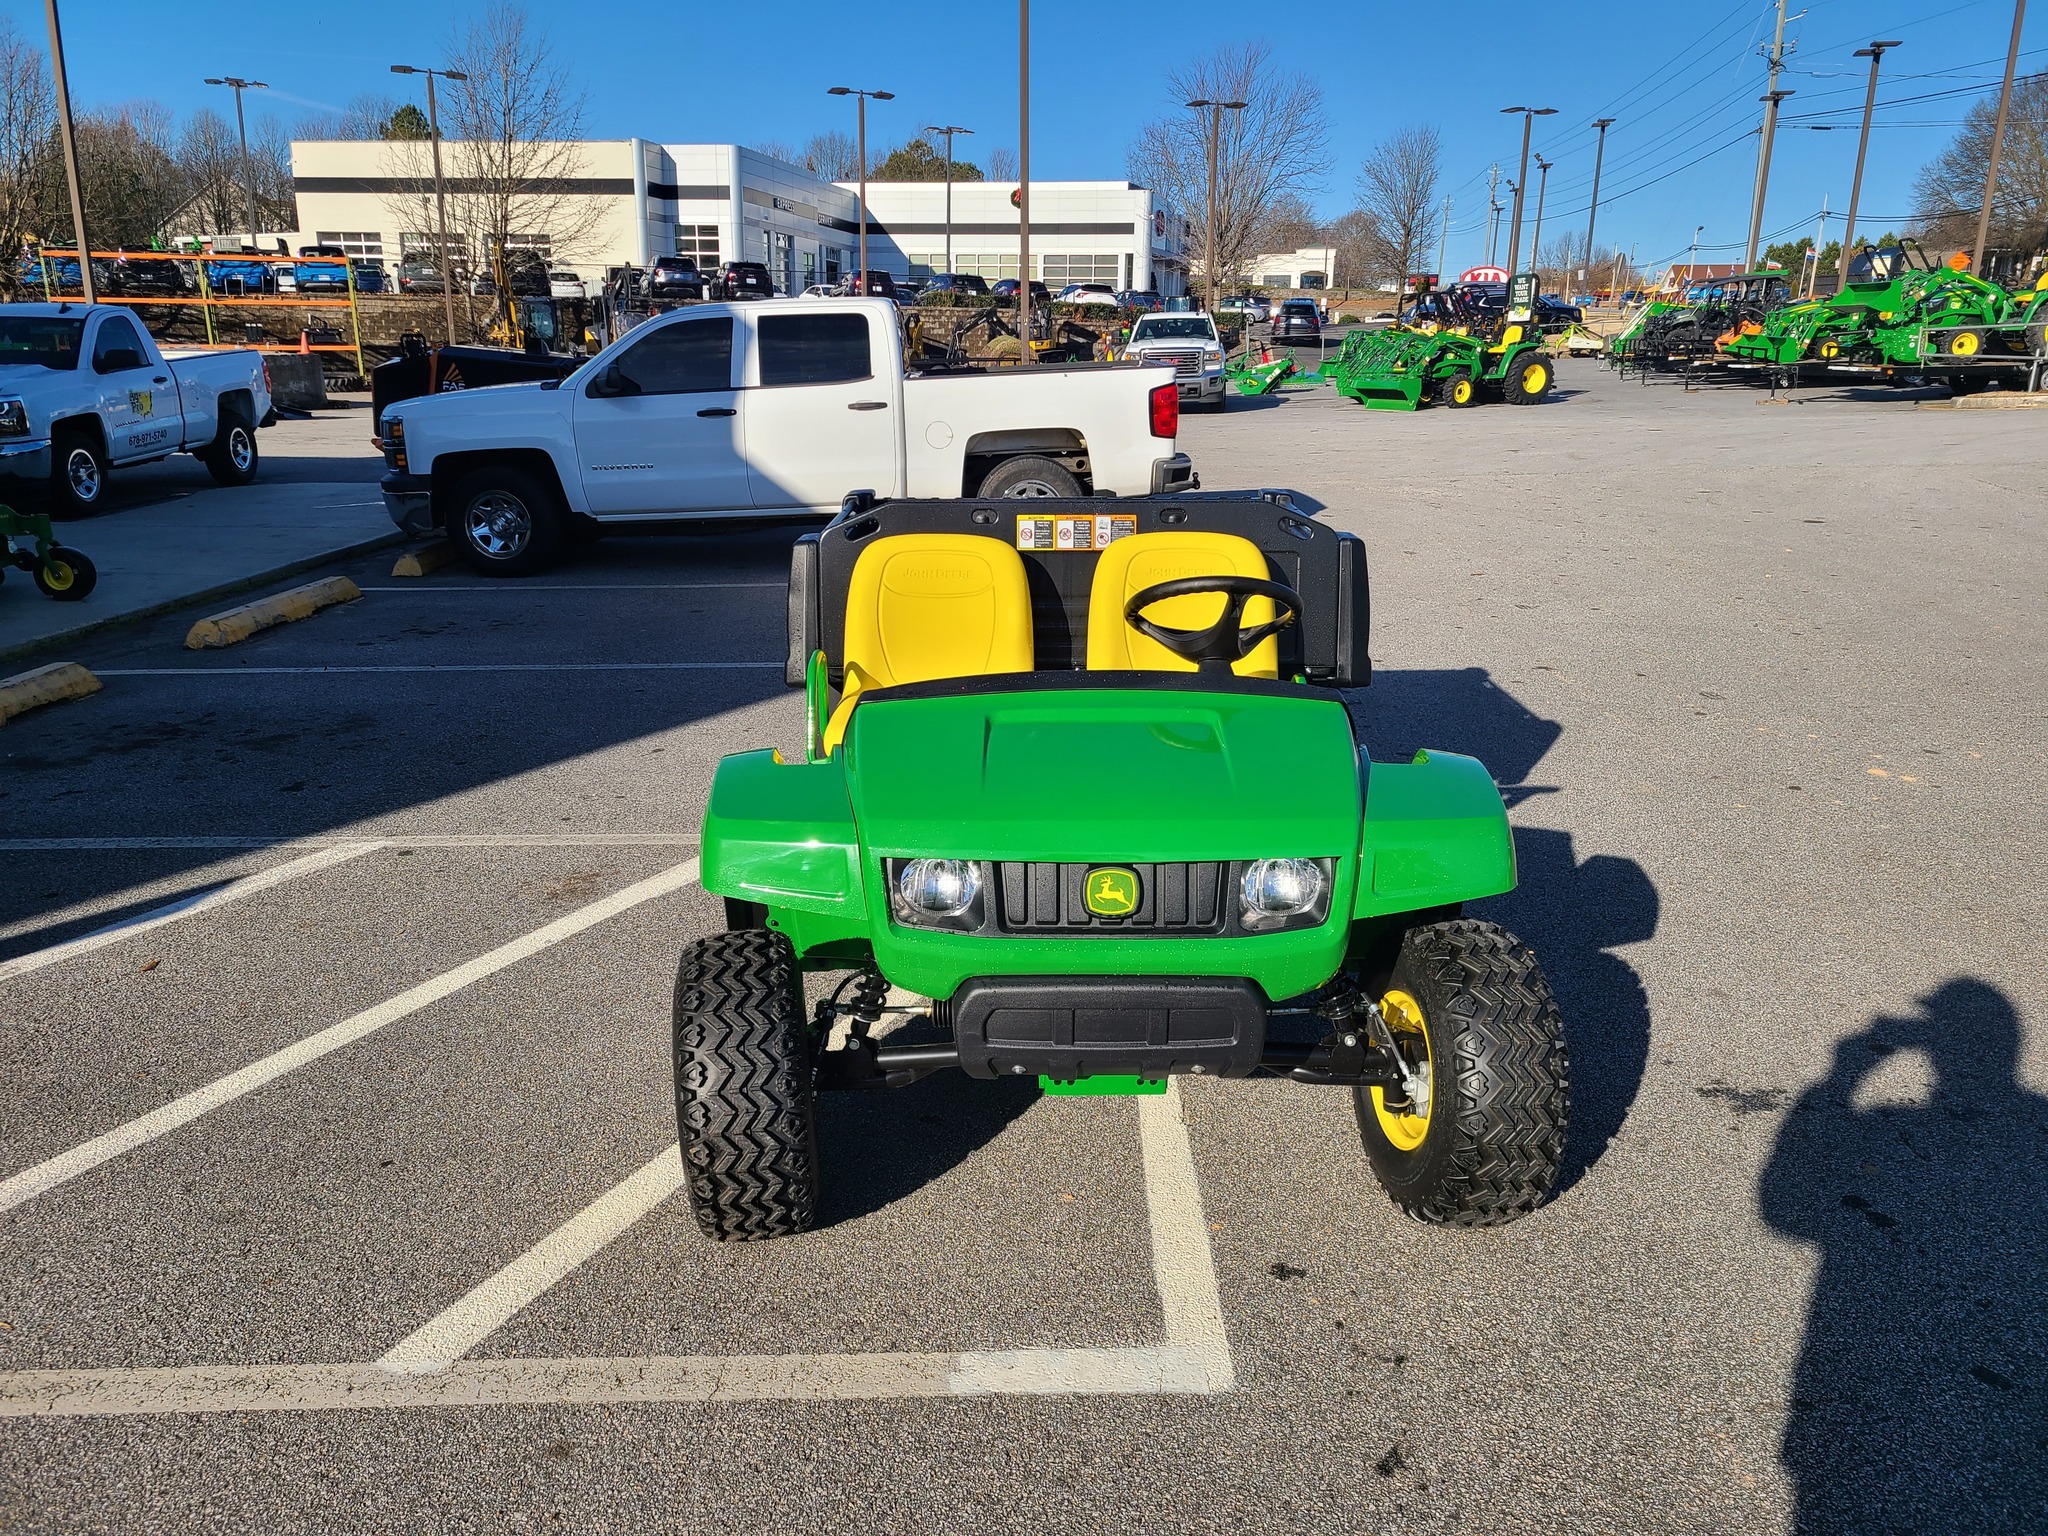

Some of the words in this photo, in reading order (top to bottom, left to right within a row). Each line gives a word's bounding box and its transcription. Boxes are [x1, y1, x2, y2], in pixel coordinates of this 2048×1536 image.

[1470, 272, 1502, 283] KIA
[1513, 296, 1530, 304] TRADE
[128, 429, 168, 446] 678-971-5740
[591, 463, 654, 471] SILVERADO
